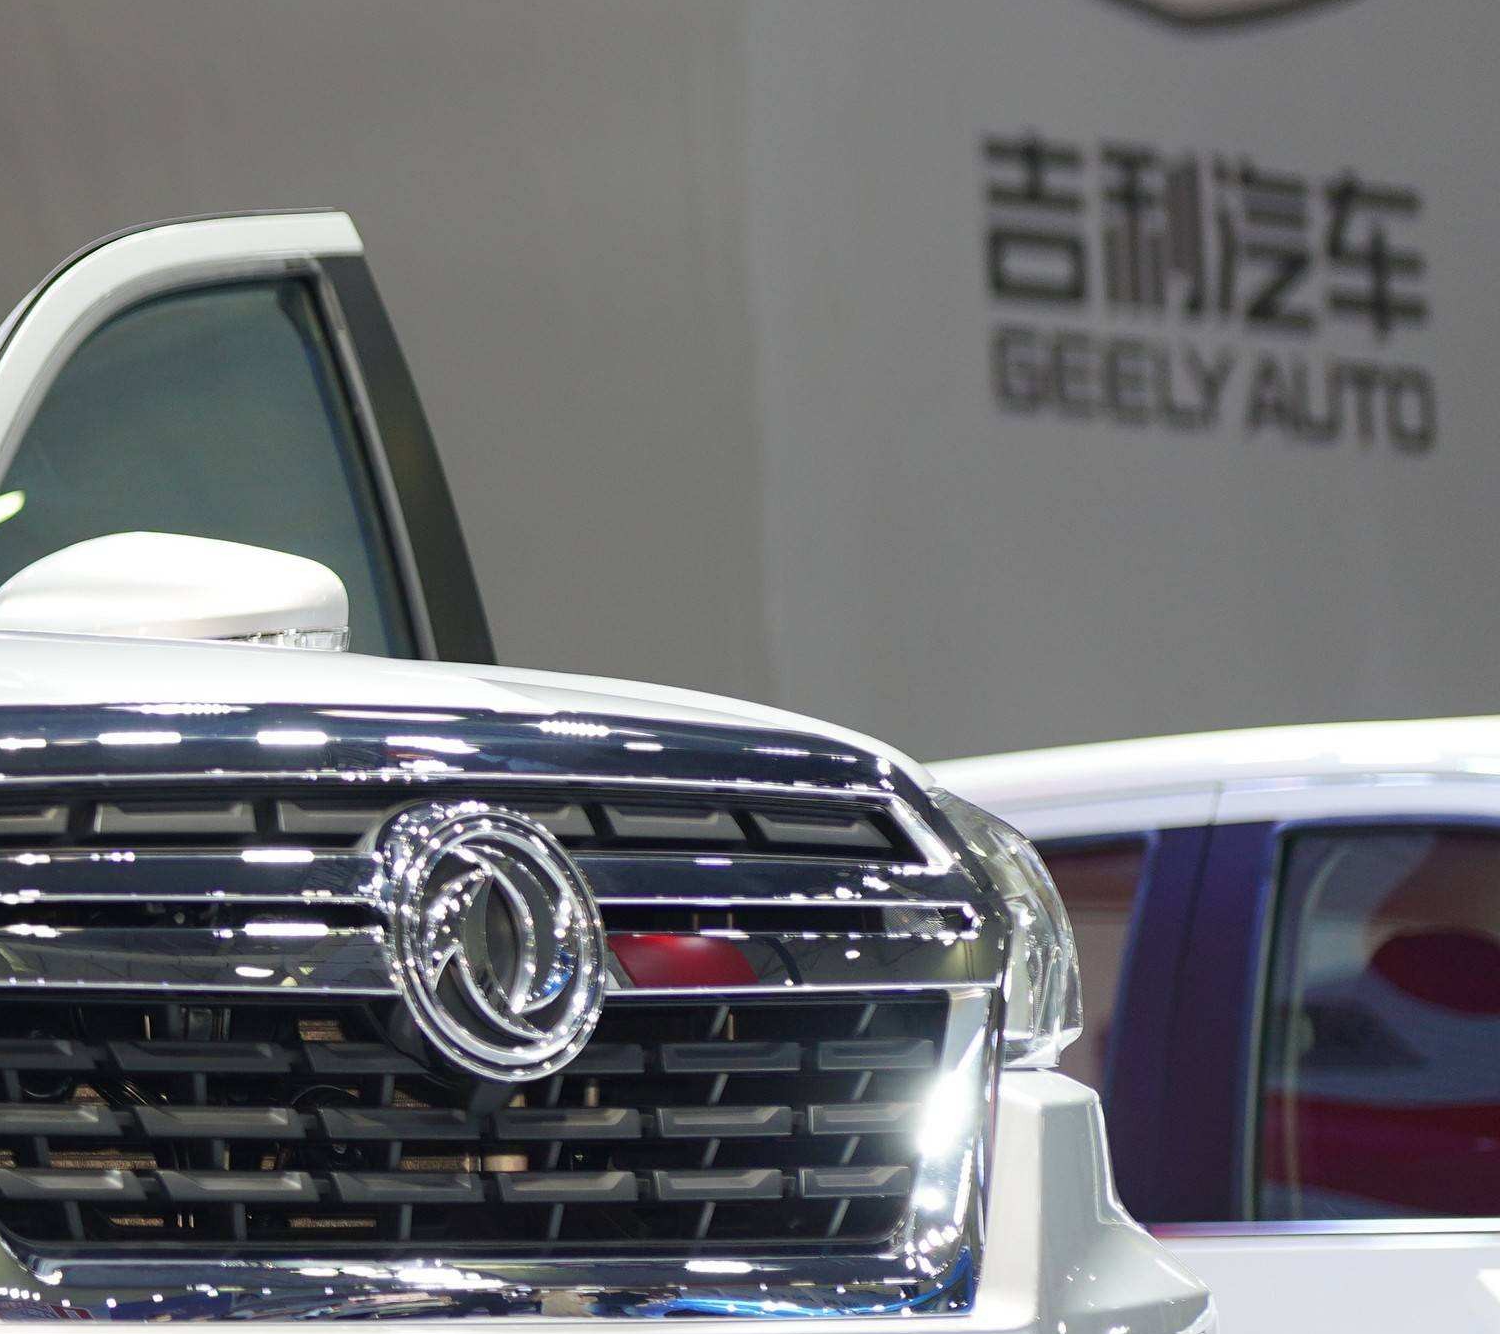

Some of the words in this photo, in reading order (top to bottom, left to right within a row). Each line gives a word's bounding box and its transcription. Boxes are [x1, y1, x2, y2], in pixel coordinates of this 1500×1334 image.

[982, 129, 1430, 341] 吉利汽车
[990, 322, 1232, 435] GEELY
[1240, 355, 1438, 458] AUTO
